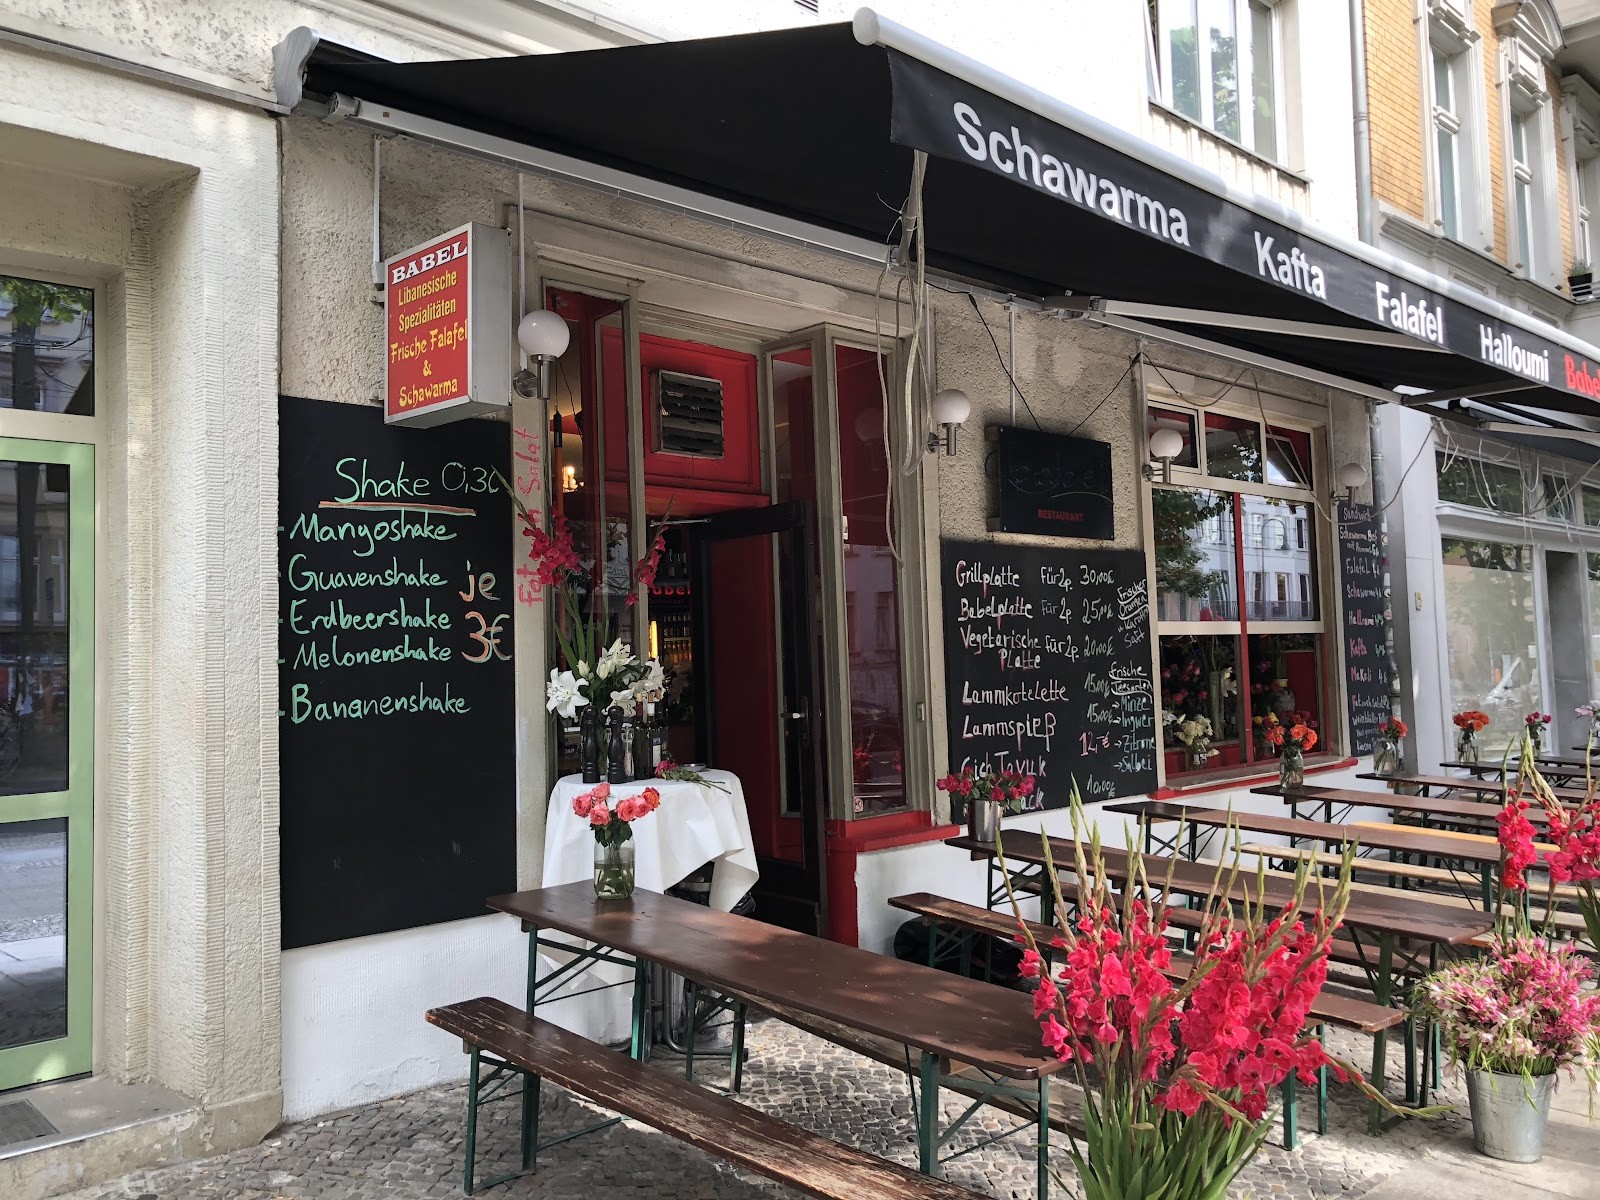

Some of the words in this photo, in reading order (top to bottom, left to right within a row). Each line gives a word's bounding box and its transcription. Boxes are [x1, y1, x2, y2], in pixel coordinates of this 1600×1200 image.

[953, 102, 1190, 247] Schawarma
[1254, 231, 1327, 300] Kafta
[1375, 281, 1443, 344] Falafel
[1479, 324, 1550, 382] Halloumi
[392, 241, 468, 285] BABEL
[398, 269, 457, 306] Libanesische
[399, 298, 456, 334] Spezialitäten
[390, 336, 427, 364] Frische
[429, 318, 468, 351] Falafel
[423, 359, 432, 377] &
[399, 378, 458, 408] Schawarma
[334, 457, 431, 504] Shake
[1037, 509, 1083, 521] RESTAURANT
[288, 553, 448, 592] Guavenshake
[459, 559, 501, 602] je
[956, 560, 1020, 598] Grillplatte
[1117, 579, 1146, 601] Frischer
[290, 597, 452, 634] Erdbeershake
[957, 596, 1033, 630] Babelplatte
[293, 634, 452, 671] Melonenshake
[461, 611, 513, 663] 3€
[960, 624, 1041, 655] Vegetarische
[291, 681, 471, 724] Bananenshake
[962, 679, 1069, 706] Lammkotelette
[1120, 695, 1150, 712] Minze
[962, 712, 1056, 752] Lammspieß
[1121, 711, 1154, 732] Ingwer
[1122, 732, 1156, 753] Zitrone
[1121, 753, 1152, 773] Salbei
